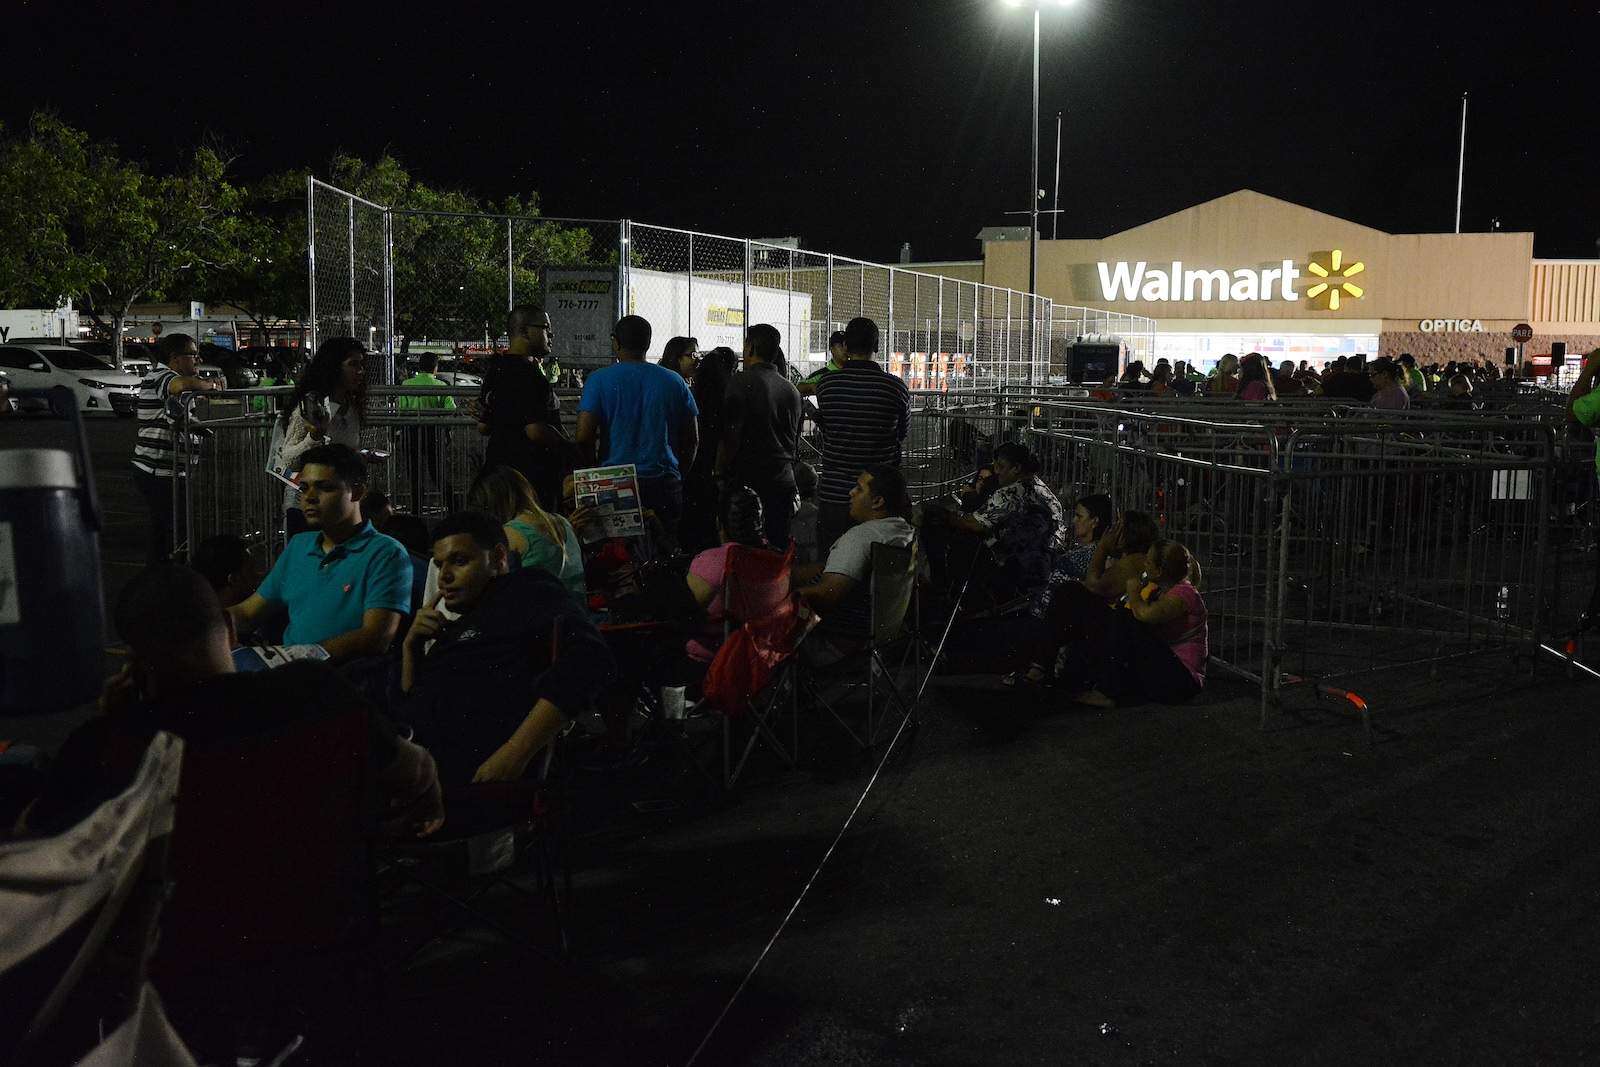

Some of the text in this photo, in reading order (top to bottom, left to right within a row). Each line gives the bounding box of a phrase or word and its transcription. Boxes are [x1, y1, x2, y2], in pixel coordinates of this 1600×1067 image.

[1097, 260, 1300, 302] Walmart
[558, 299, 599, 309] 776-7777
[1420, 319, 1484, 333] OPTICA
[1513, 328, 1533, 338] PARE
